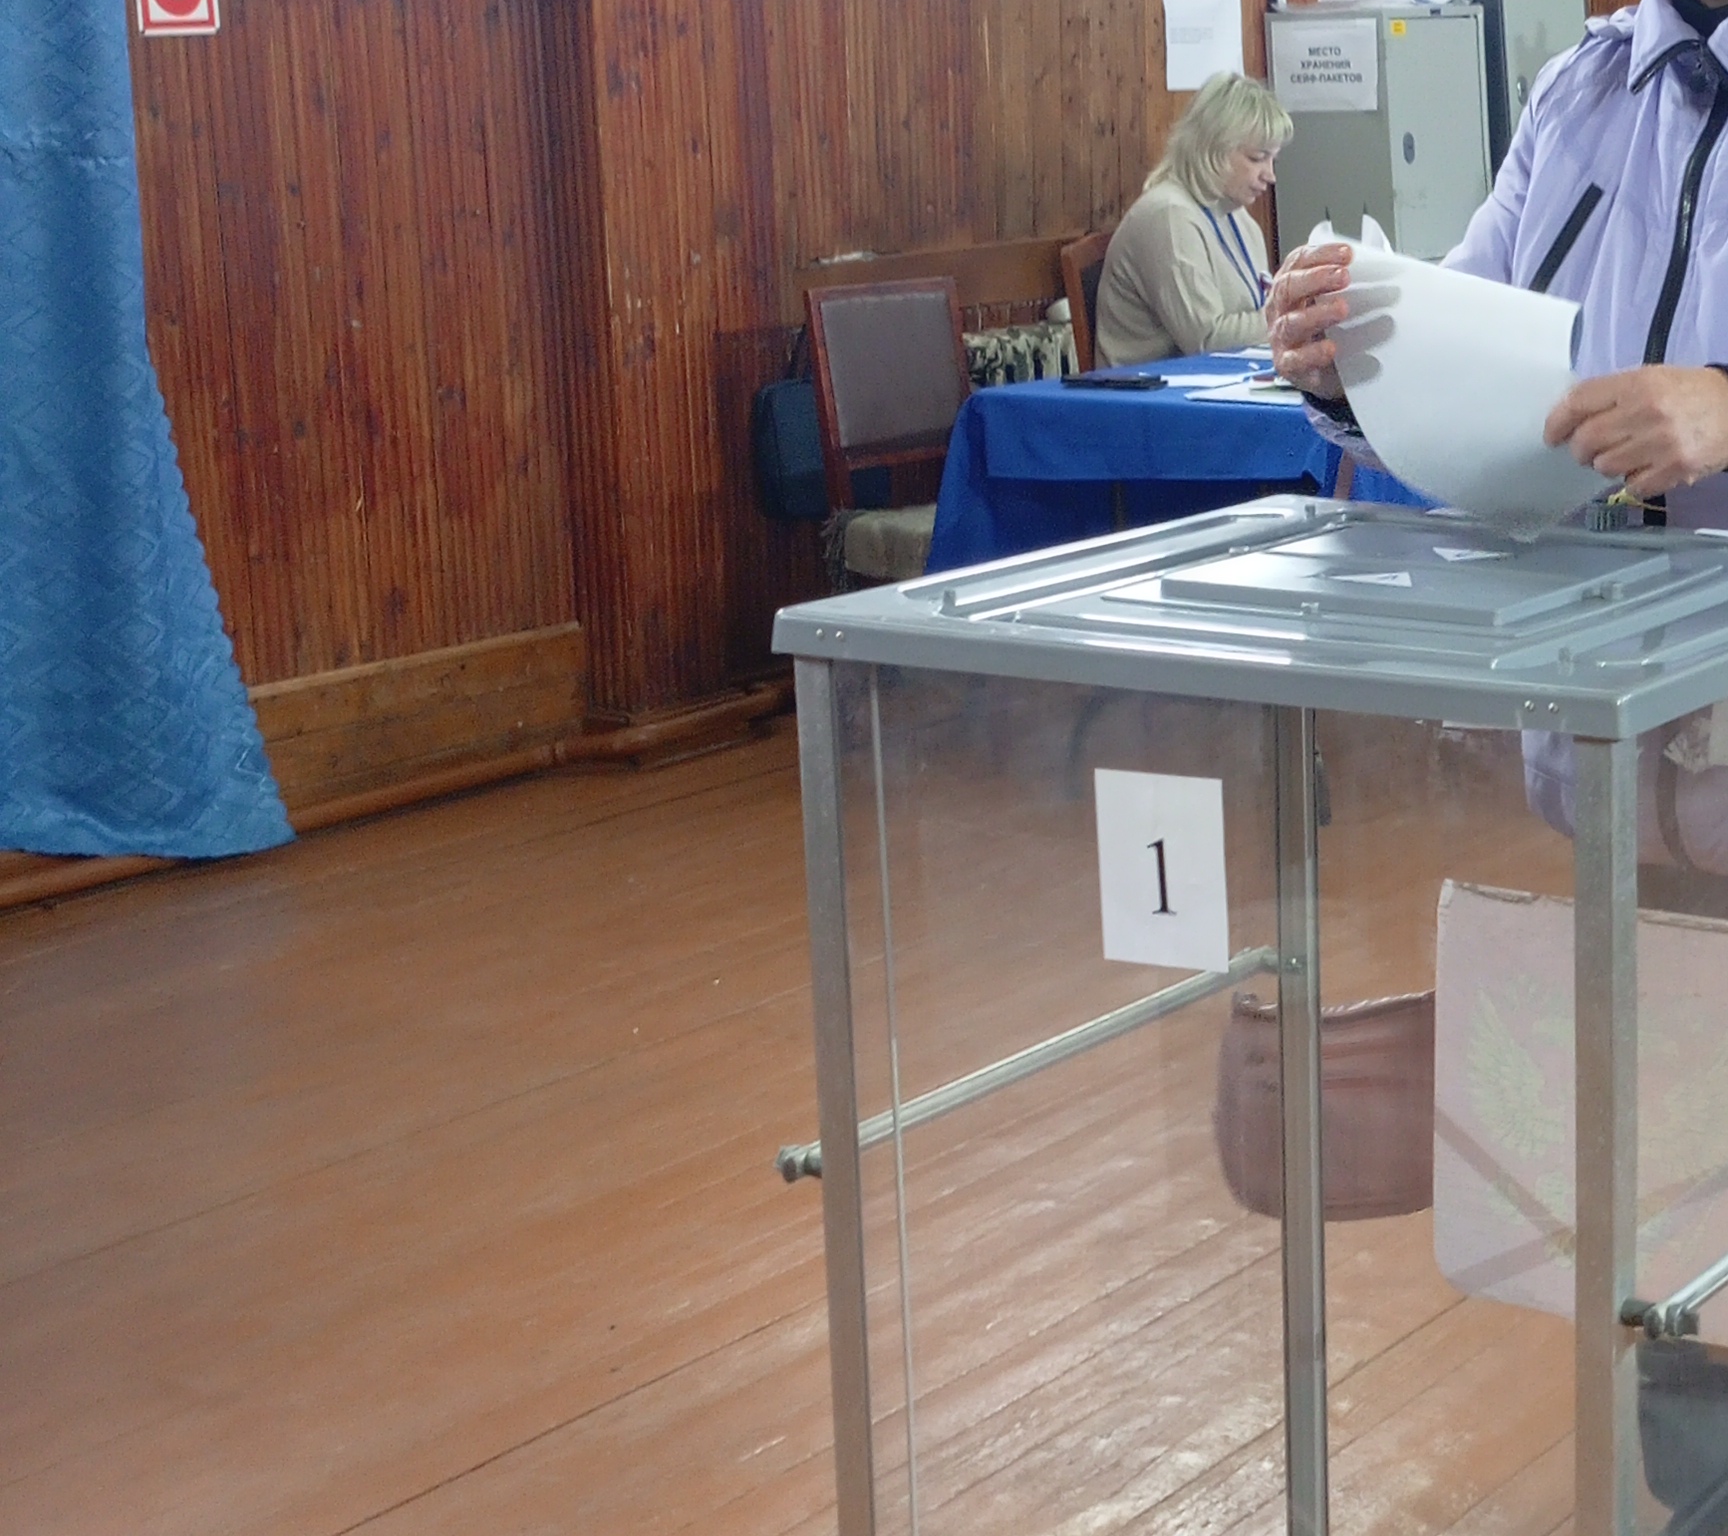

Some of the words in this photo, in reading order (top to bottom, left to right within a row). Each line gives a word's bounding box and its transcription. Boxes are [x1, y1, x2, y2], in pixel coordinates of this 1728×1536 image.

[1308, 47, 1341, 56] МЕСТО
[1300, 60, 1351, 70] ХРАНЕНИЯ
[1290, 72, 1363, 83] СЕЙФ-ПАКЕТОВ
[1147, 837, 1177, 915] 1
